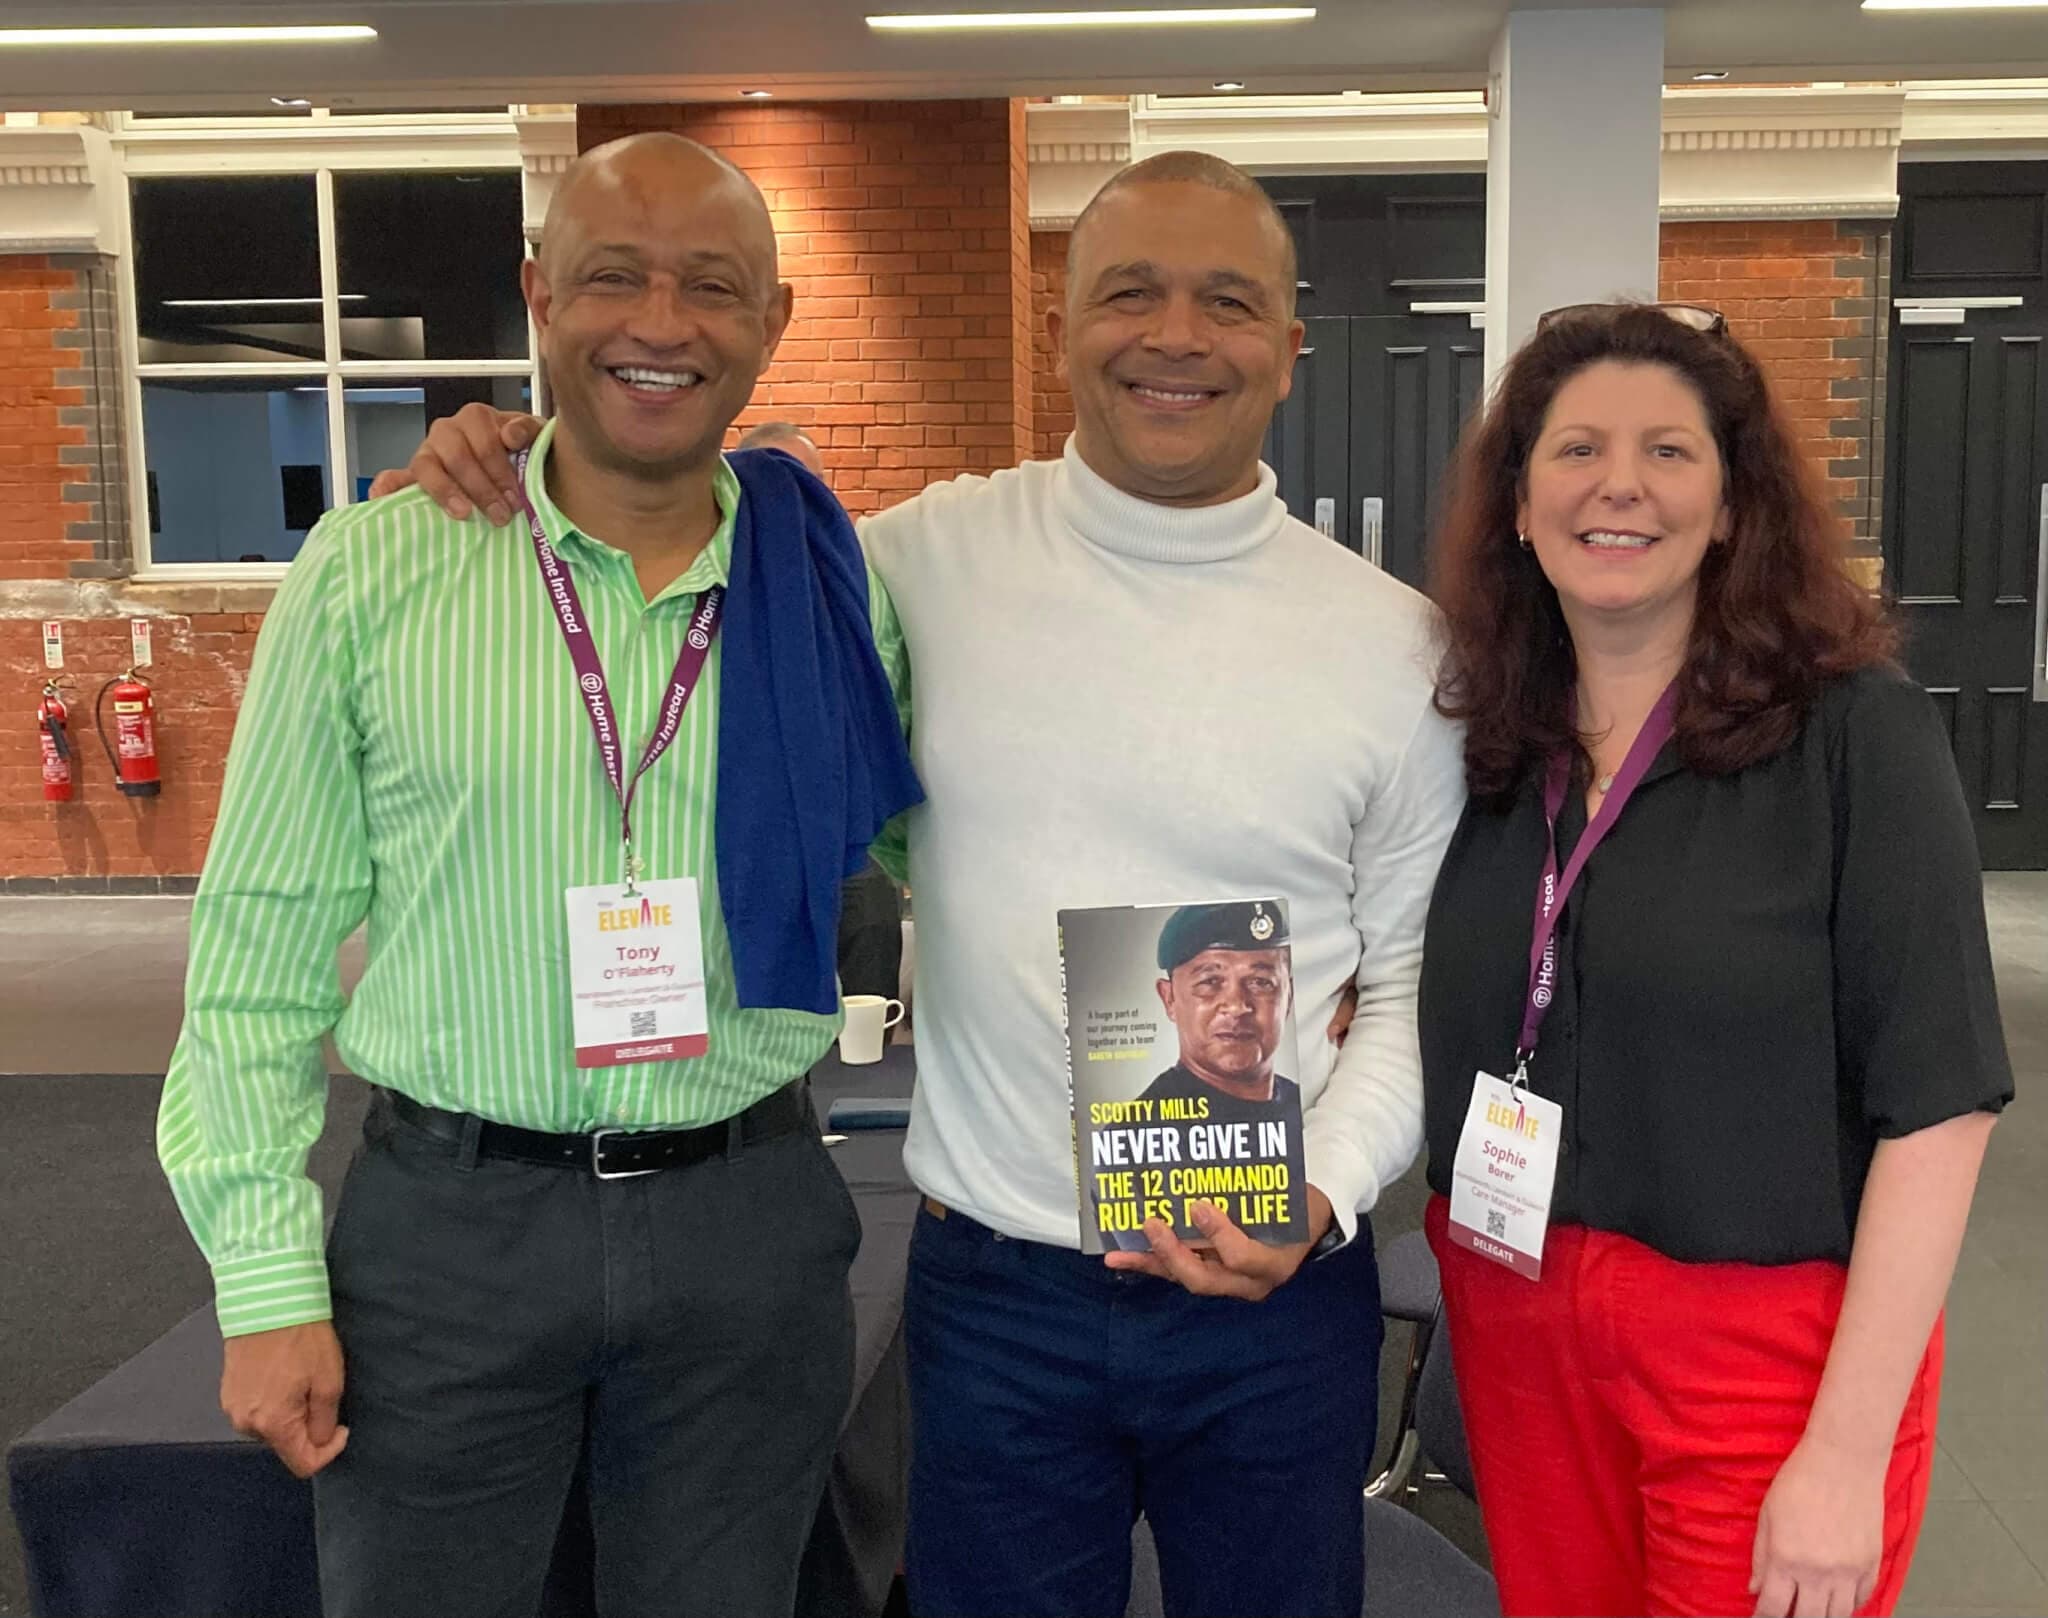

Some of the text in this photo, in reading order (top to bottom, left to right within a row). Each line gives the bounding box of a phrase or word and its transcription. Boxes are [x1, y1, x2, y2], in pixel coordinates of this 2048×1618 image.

[538, 534, 582, 634] Home Instead
[695, 589, 720, 631] Home
[588, 694, 611, 742] Home
[660, 683, 686, 741] Instead
[598, 898, 673, 932] ELEVATE
[616, 946, 661, 962] Tony
[603, 964, 676, 980] O'Flaherty
[1101, 1023, 1128, 1035] journey
[1130, 1022, 1157, 1033] coming
[1115, 1009, 1130, 1020] part
[1088, 1037, 1117, 1049] together
[1091, 1097, 1209, 1124] SCOTTY MILLS
[1486, 1103, 1540, 1141] ELEVATE
[1091, 1127, 1182, 1166] NEVER
[1189, 1123, 1251, 1161] GIVE
[1258, 1121, 1287, 1158] IN
[1482, 1140, 1527, 1169] Sophie
[1095, 1163, 1289, 1199] THE 12 COMMANDO
[1488, 1163, 1516, 1182] Borer
[1240, 1193, 1291, 1224] LIFE
[1471, 1186, 1489, 1201] Care
[1491, 1193, 1527, 1217] Manager
[1472, 1236, 1515, 1264] DELEGATE
